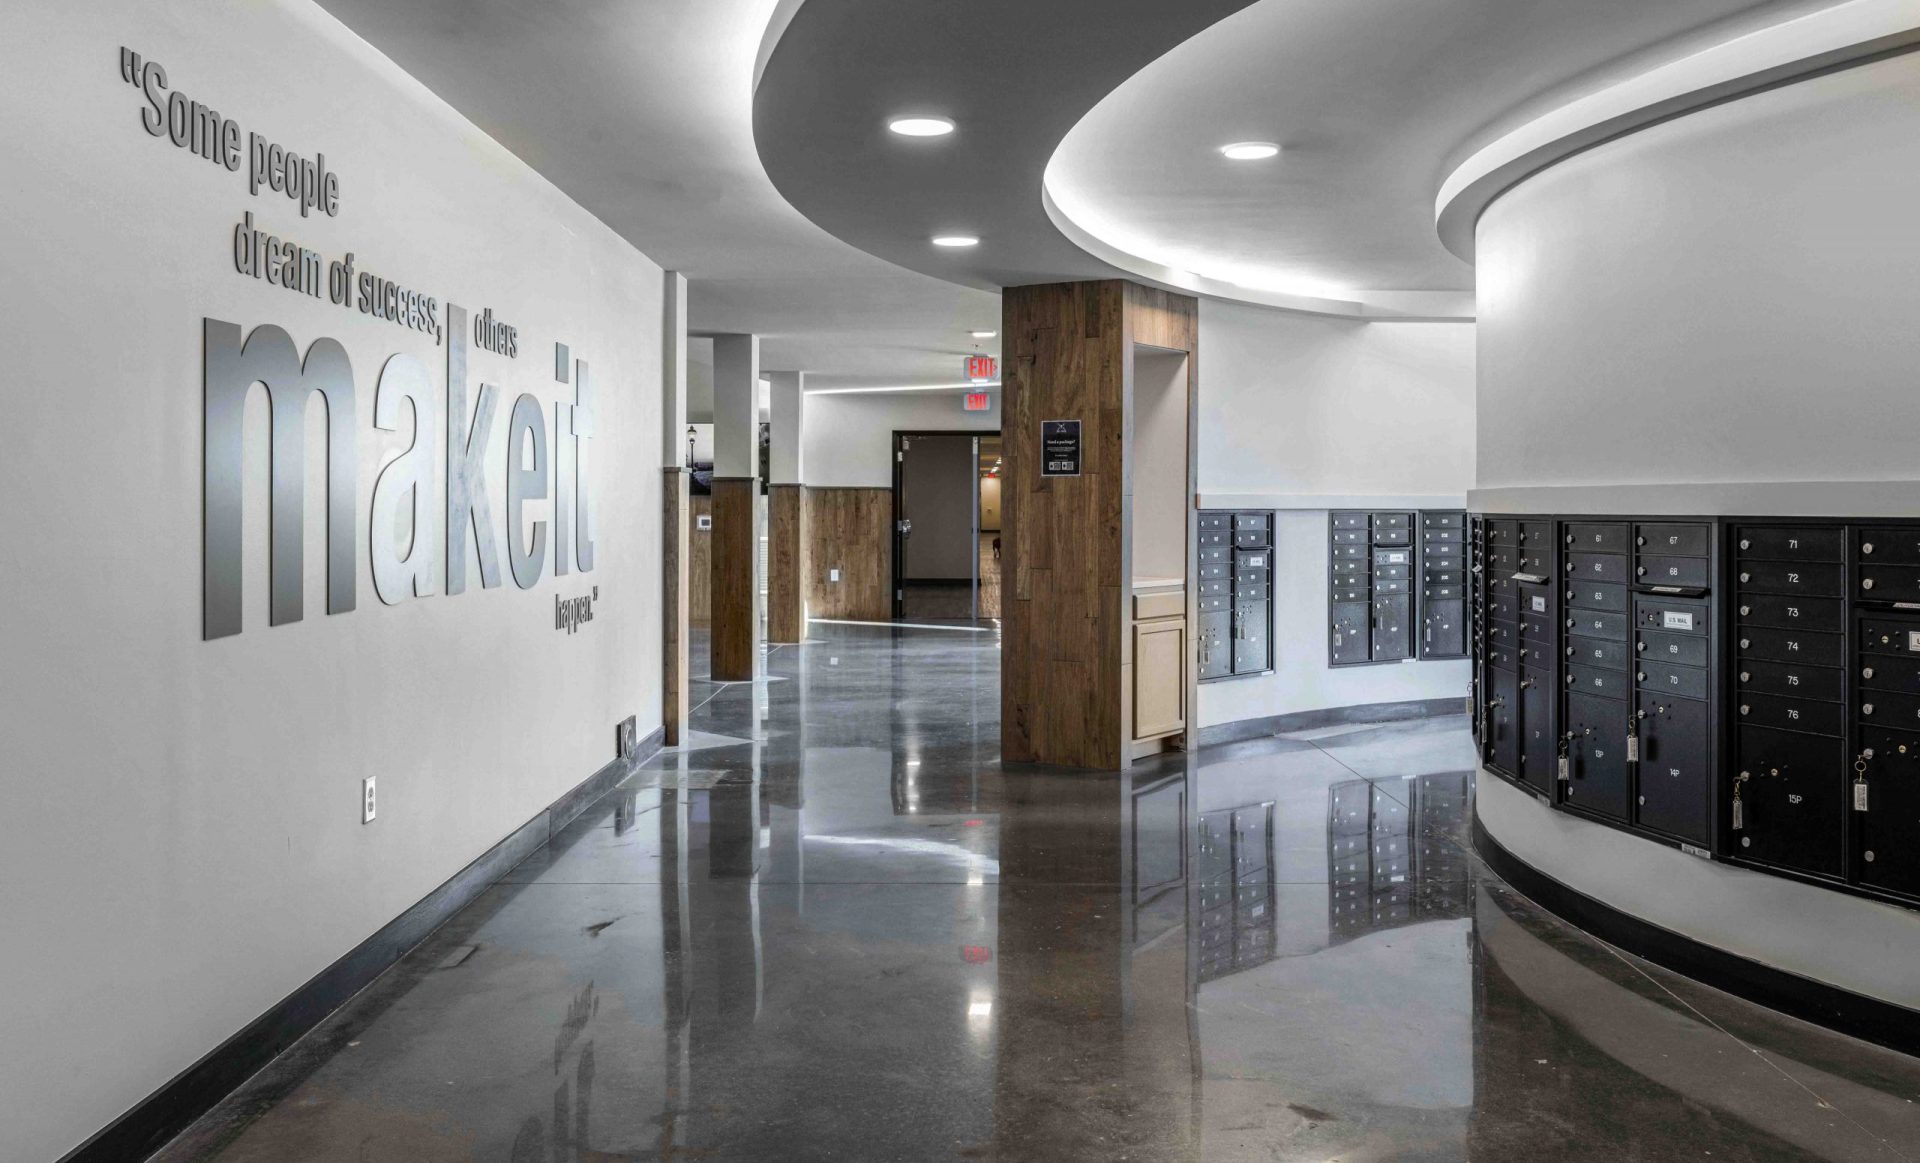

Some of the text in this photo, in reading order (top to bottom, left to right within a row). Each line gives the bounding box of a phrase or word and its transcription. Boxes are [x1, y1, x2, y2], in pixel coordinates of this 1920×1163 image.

[120, 45, 340, 218] “Some people
[233, 210, 518, 359] dream of success, others
[968, 357, 994, 378] EXIT
[967, 393, 987, 411] EXIT
[1595, 534, 1602, 543] 61
[1669, 536, 1678, 545] 67
[1788, 539, 1798, 549] 71
[1594, 563, 1602, 572] 62
[1669, 567, 1678, 576] 68
[1787, 573, 1799, 583] 72
[1594, 591, 1603, 600] 63
[1787, 607, 1799, 617] 73
[1594, 620, 1603, 629] 64
[1669, 644, 1679, 654] 69
[1787, 641, 1799, 651] 74
[1594, 649, 1603, 658] 65
[1594, 678, 1603, 687] 66
[1669, 675, 1679, 685] 70
[1787, 675, 1799, 686] 75
[1787, 709, 1799, 720] 76
[1788, 793, 1803, 804] 15P
